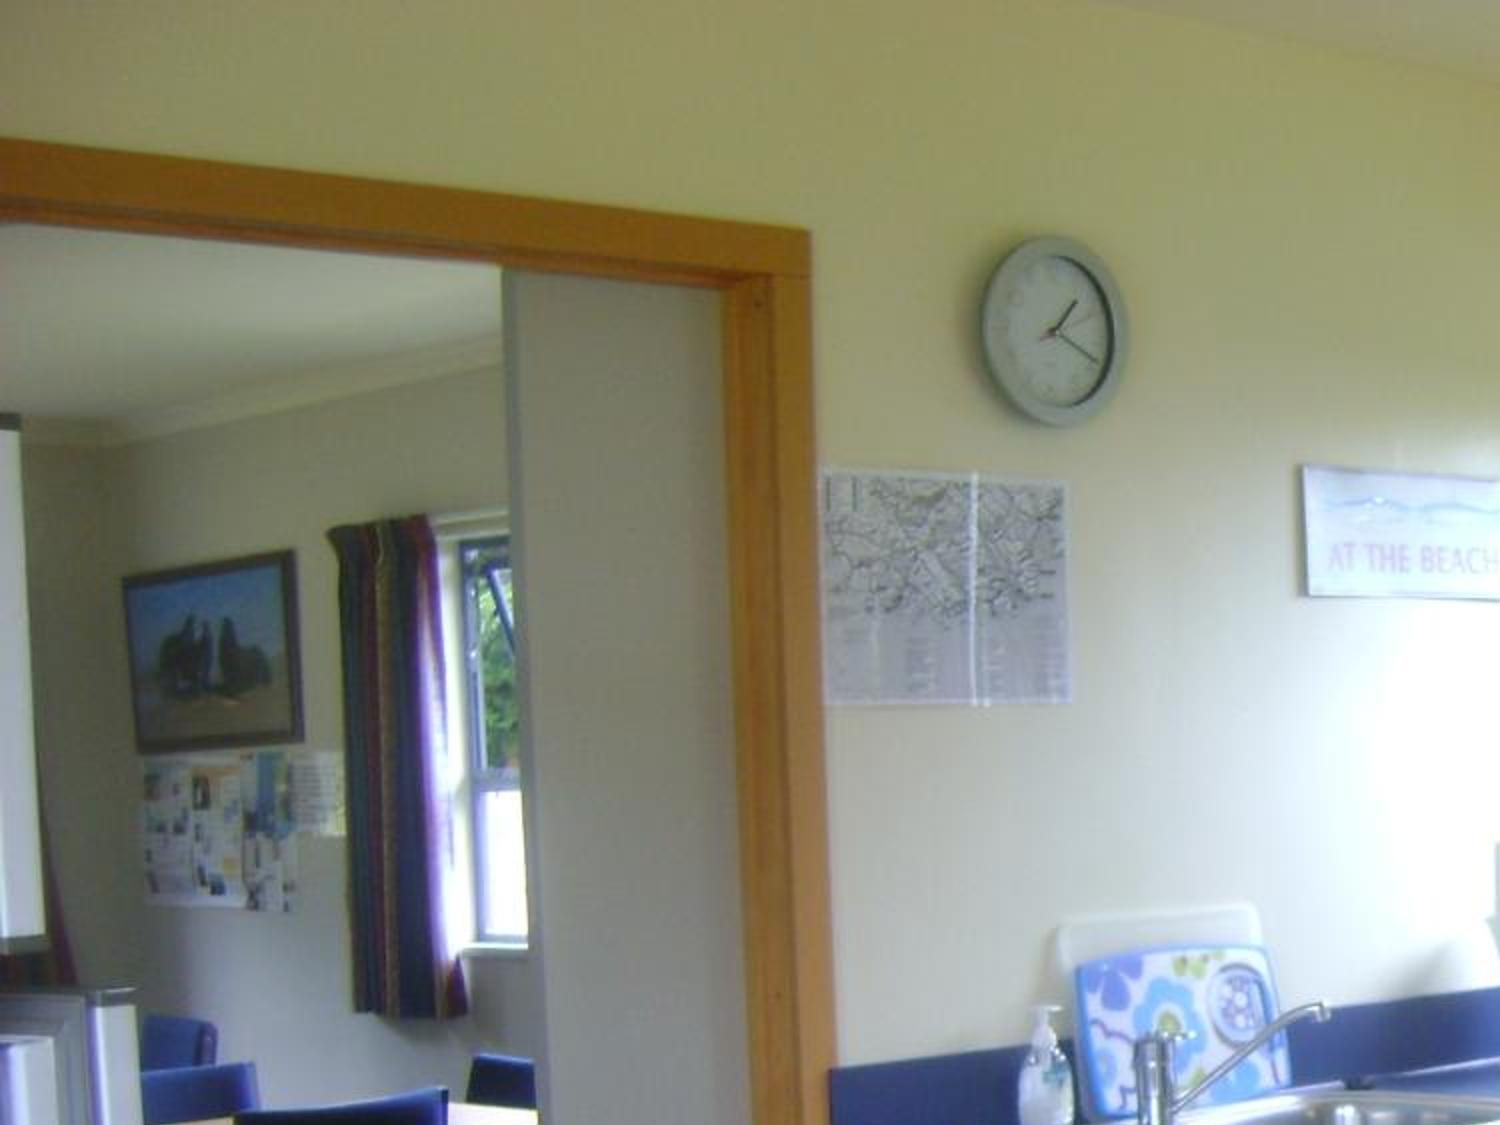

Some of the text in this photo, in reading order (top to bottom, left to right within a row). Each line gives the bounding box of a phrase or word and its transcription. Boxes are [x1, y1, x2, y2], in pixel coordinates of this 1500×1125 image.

[1328, 543, 1500, 575] AT THE BEACH
